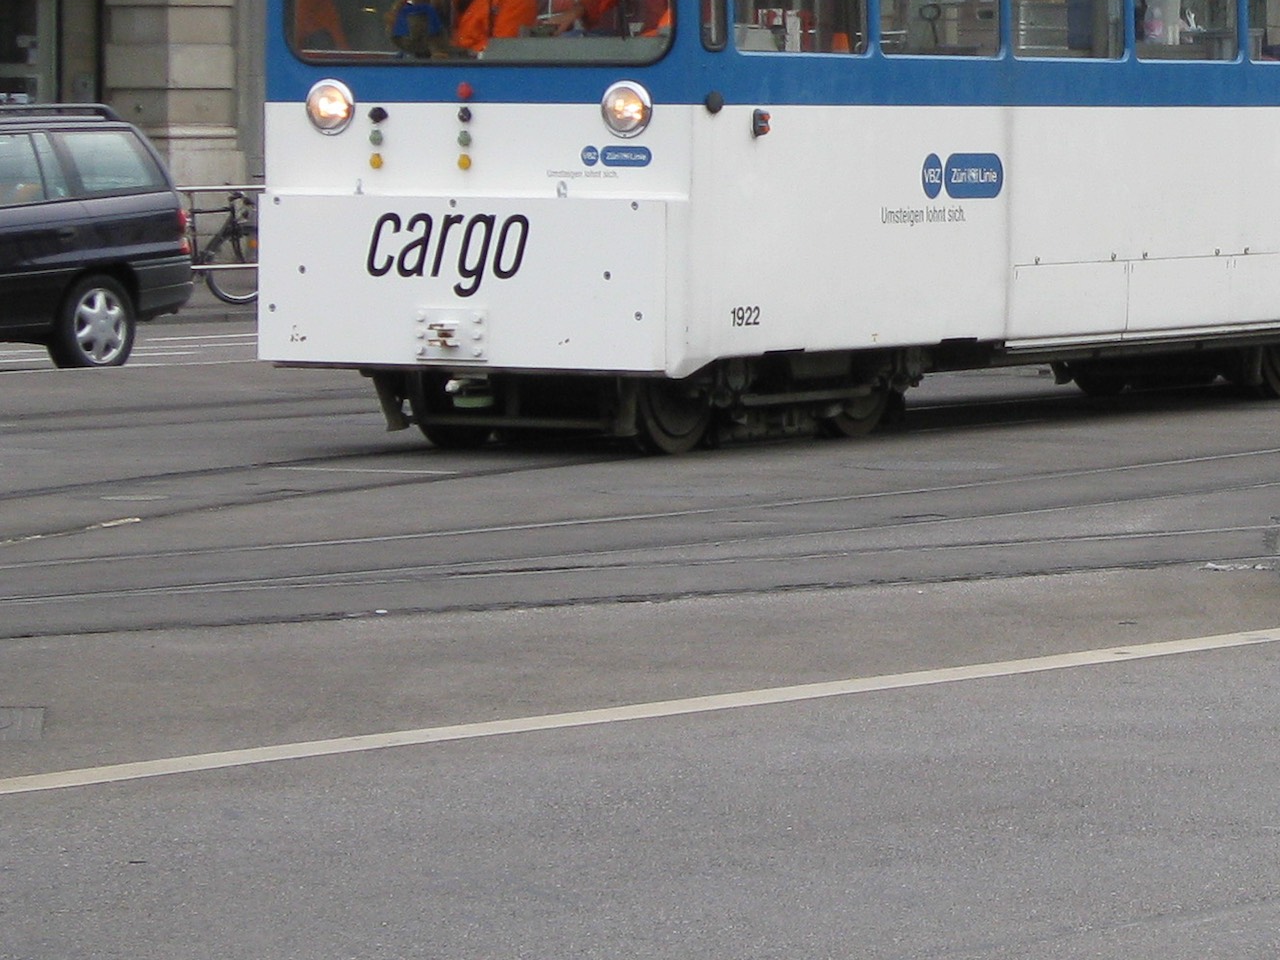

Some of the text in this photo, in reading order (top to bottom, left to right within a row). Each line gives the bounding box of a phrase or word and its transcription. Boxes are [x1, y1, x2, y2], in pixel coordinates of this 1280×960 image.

[924, 168, 941, 183] VBZ
[979, 168, 997, 183] Linie
[881, 206, 966, 226] Umsteigen lohnt sich.
[367, 212, 529, 298] cargo
[731, 306, 760, 327] 1922
